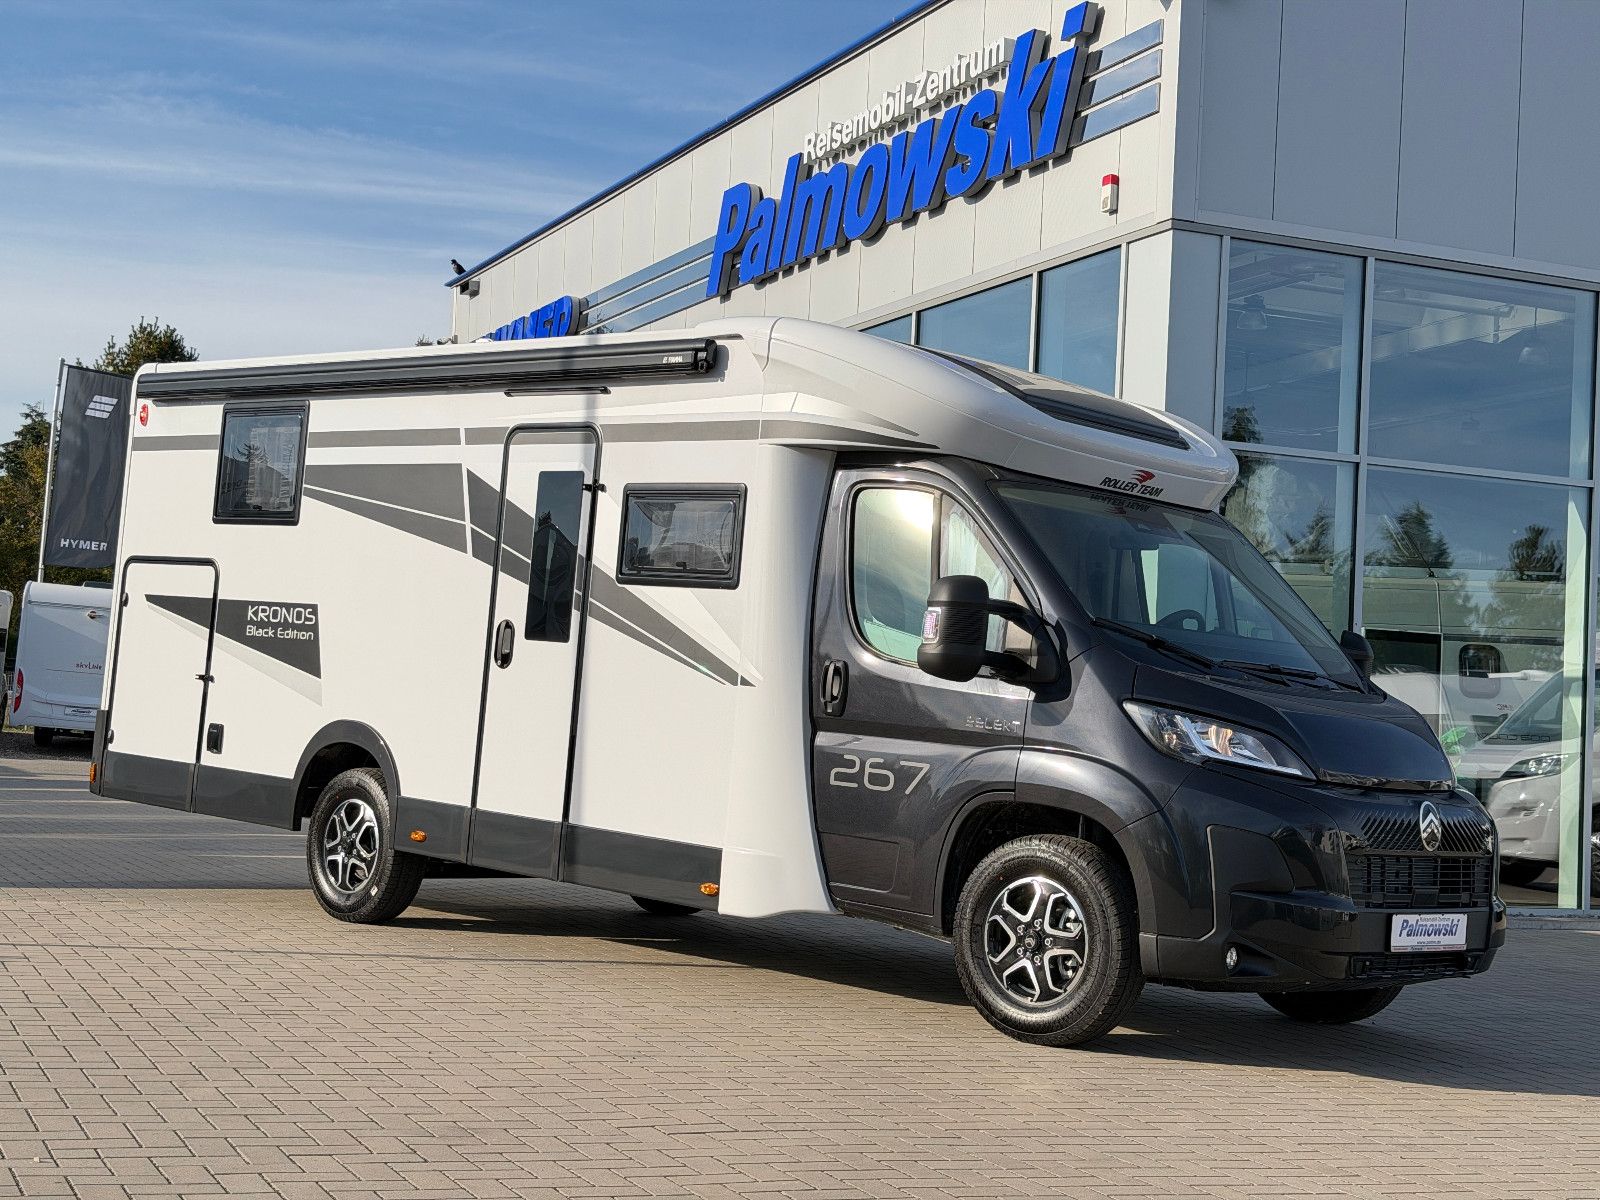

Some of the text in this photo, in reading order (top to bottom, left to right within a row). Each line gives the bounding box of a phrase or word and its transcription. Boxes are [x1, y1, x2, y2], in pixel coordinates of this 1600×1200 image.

[803, 37, 1006, 164] Reisemobil-Zentrum
[706, 1, 1092, 297] Palmowski
[1100, 476, 1164, 497] ROLLER TEAM
[60, 538, 108, 551] HYMER
[247, 605, 316, 625] KRONOS
[246, 625, 314, 640] Black Edition
[829, 754, 931, 795] 267
[1399, 918, 1460, 938] Palmowski
